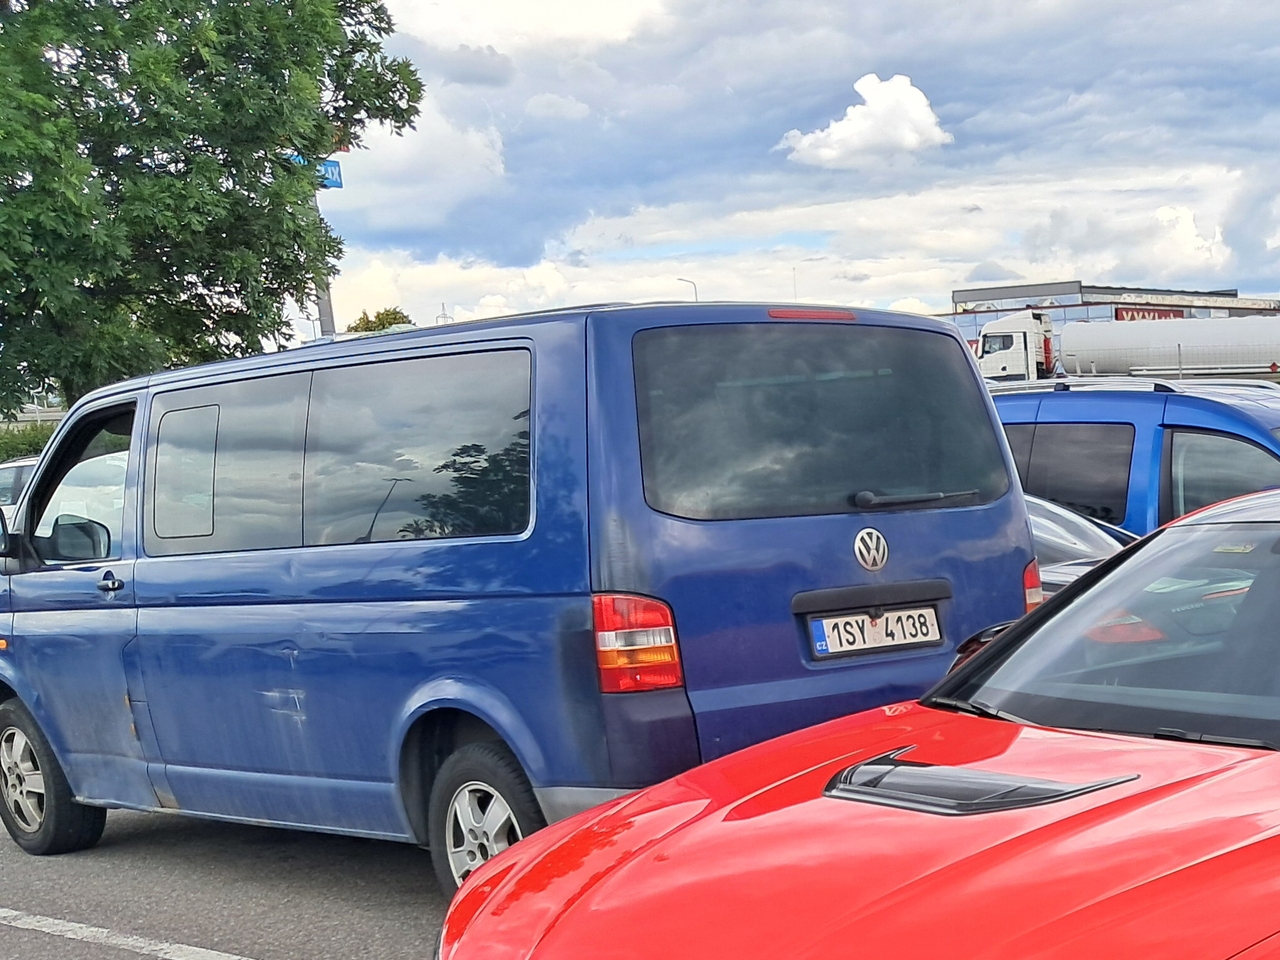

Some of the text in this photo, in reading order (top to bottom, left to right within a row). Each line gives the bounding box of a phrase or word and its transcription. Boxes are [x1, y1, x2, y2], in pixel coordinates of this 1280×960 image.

[831, 612, 930, 648] 1SY 4138
[816, 641, 828, 651] CZ
